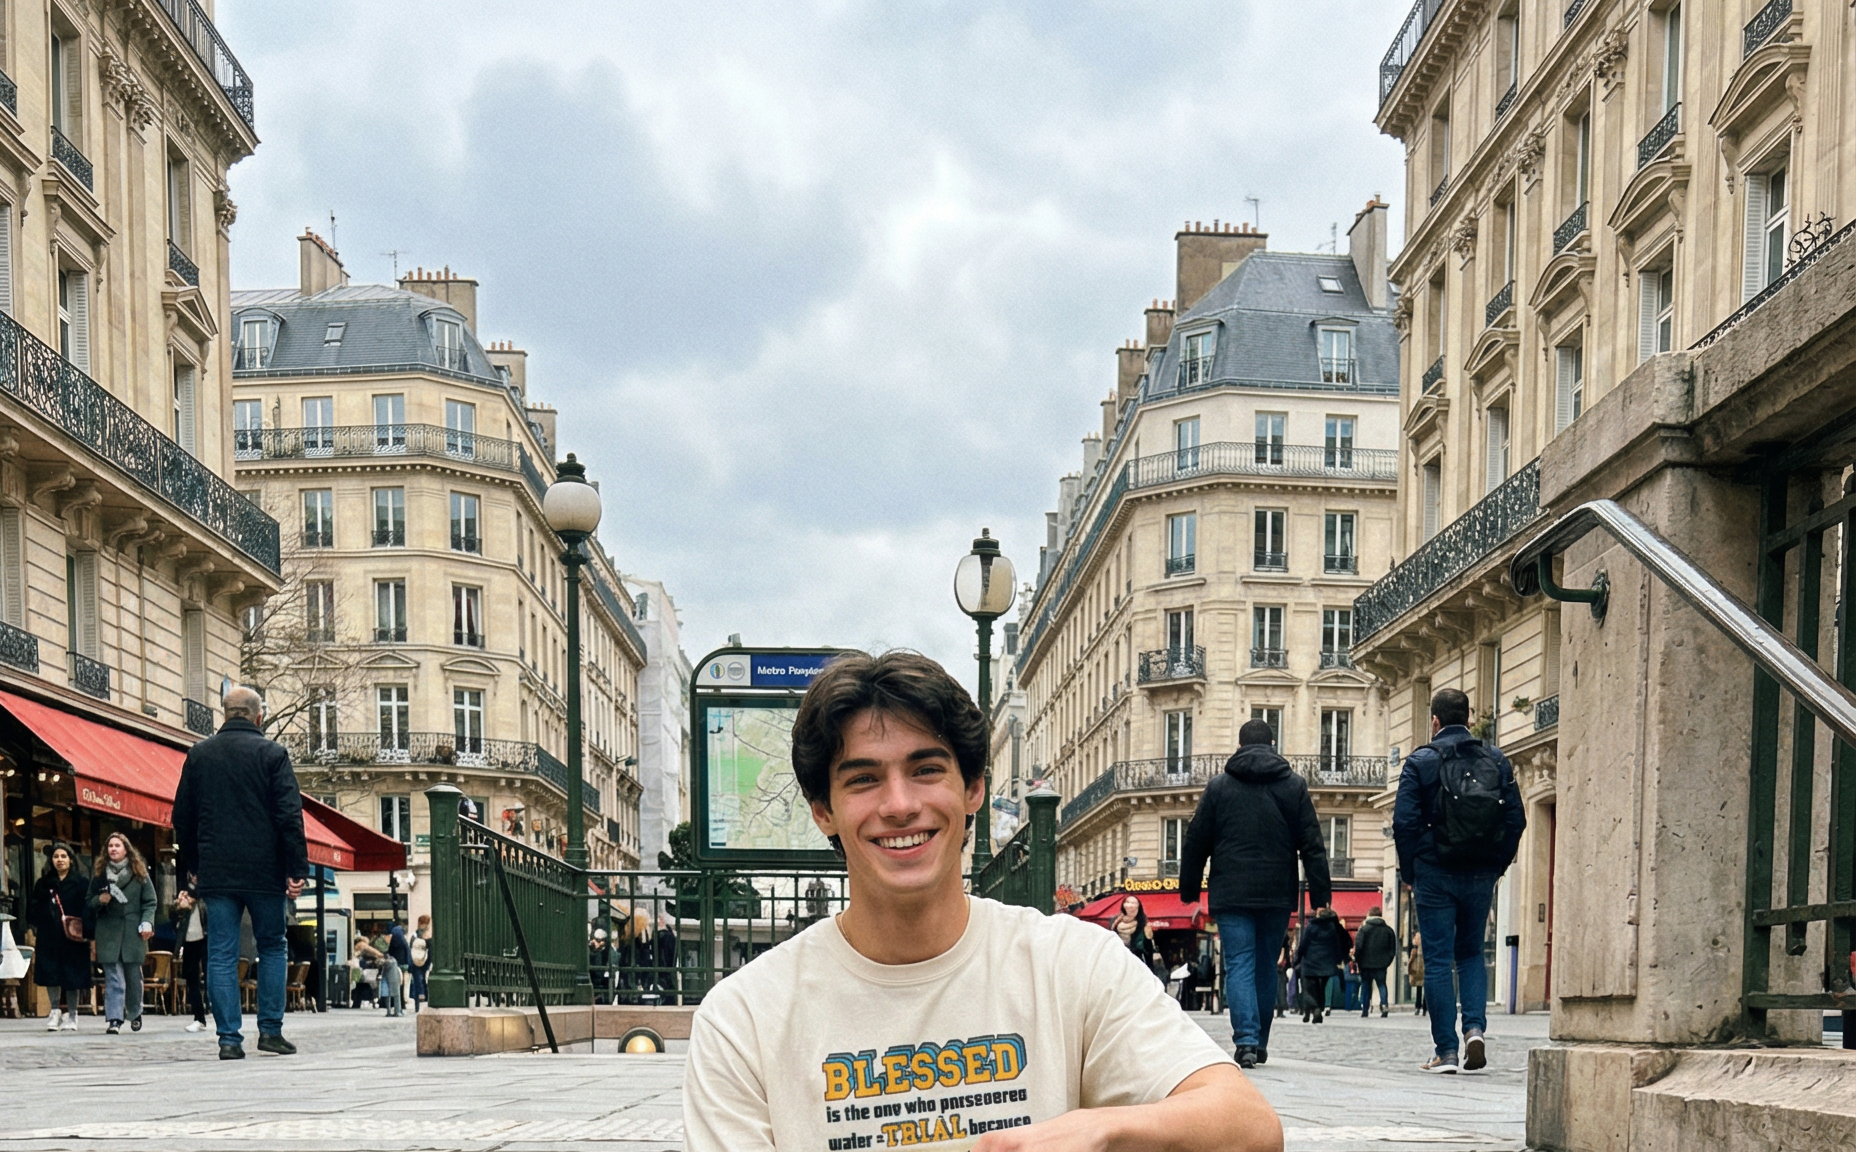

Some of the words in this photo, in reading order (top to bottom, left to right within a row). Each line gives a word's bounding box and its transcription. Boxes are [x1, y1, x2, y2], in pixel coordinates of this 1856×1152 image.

[822, 1033, 1027, 1101] BLESSED
[826, 1106, 841, 1123] is
[844, 1104, 870, 1121] the
[904, 1097, 936, 1114] who
